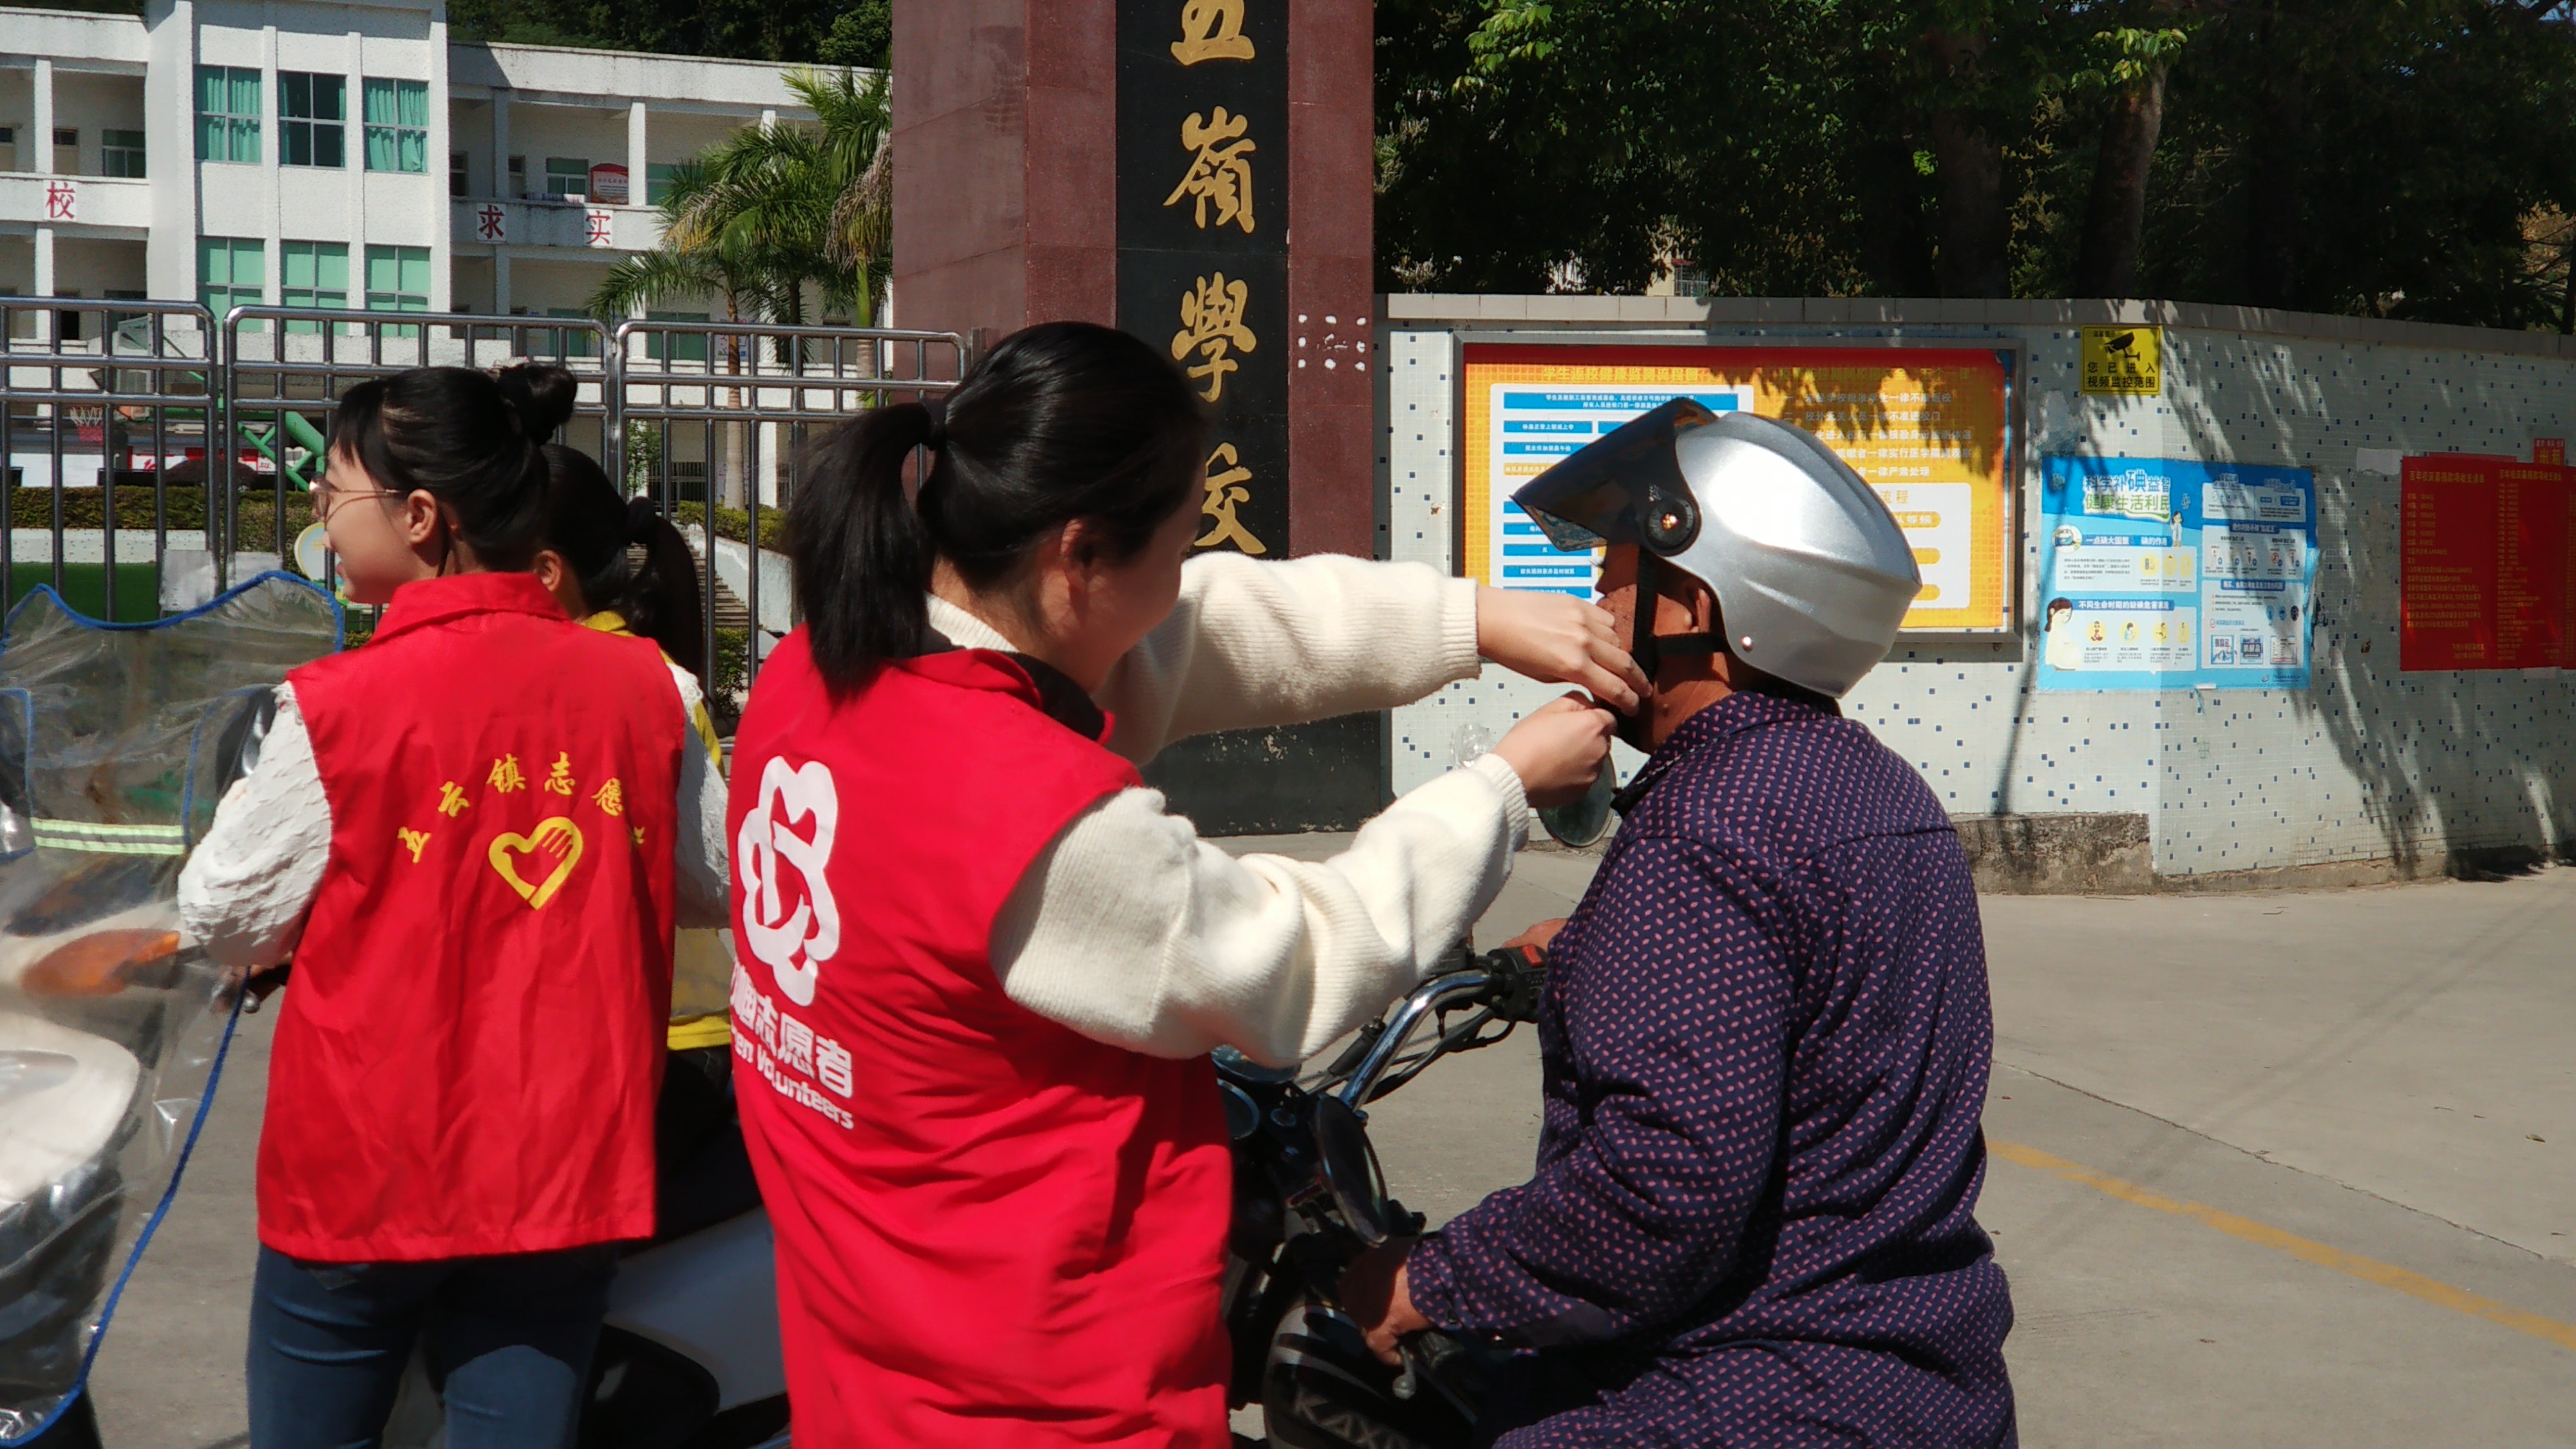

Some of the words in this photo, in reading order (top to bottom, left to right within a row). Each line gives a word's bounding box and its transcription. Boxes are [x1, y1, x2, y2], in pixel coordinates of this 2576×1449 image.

[44, 180, 77, 222] 校
[478, 204, 505, 241] 求
[585, 209, 612, 246] 实
[2087, 362, 2155, 374] 您已进入
[2087, 376, 2156, 388] 视频监控范围
[1810, 430, 1973, 440] 生进入校门一律核验身份检测体温
[2085, 471, 2170, 493] 科学补碘益智
[2085, 493, 2170, 511] 健康生活利民
[730, 960, 853, 1099] 帼志愿者
[756, 1043, 855, 1130] Volunteers
